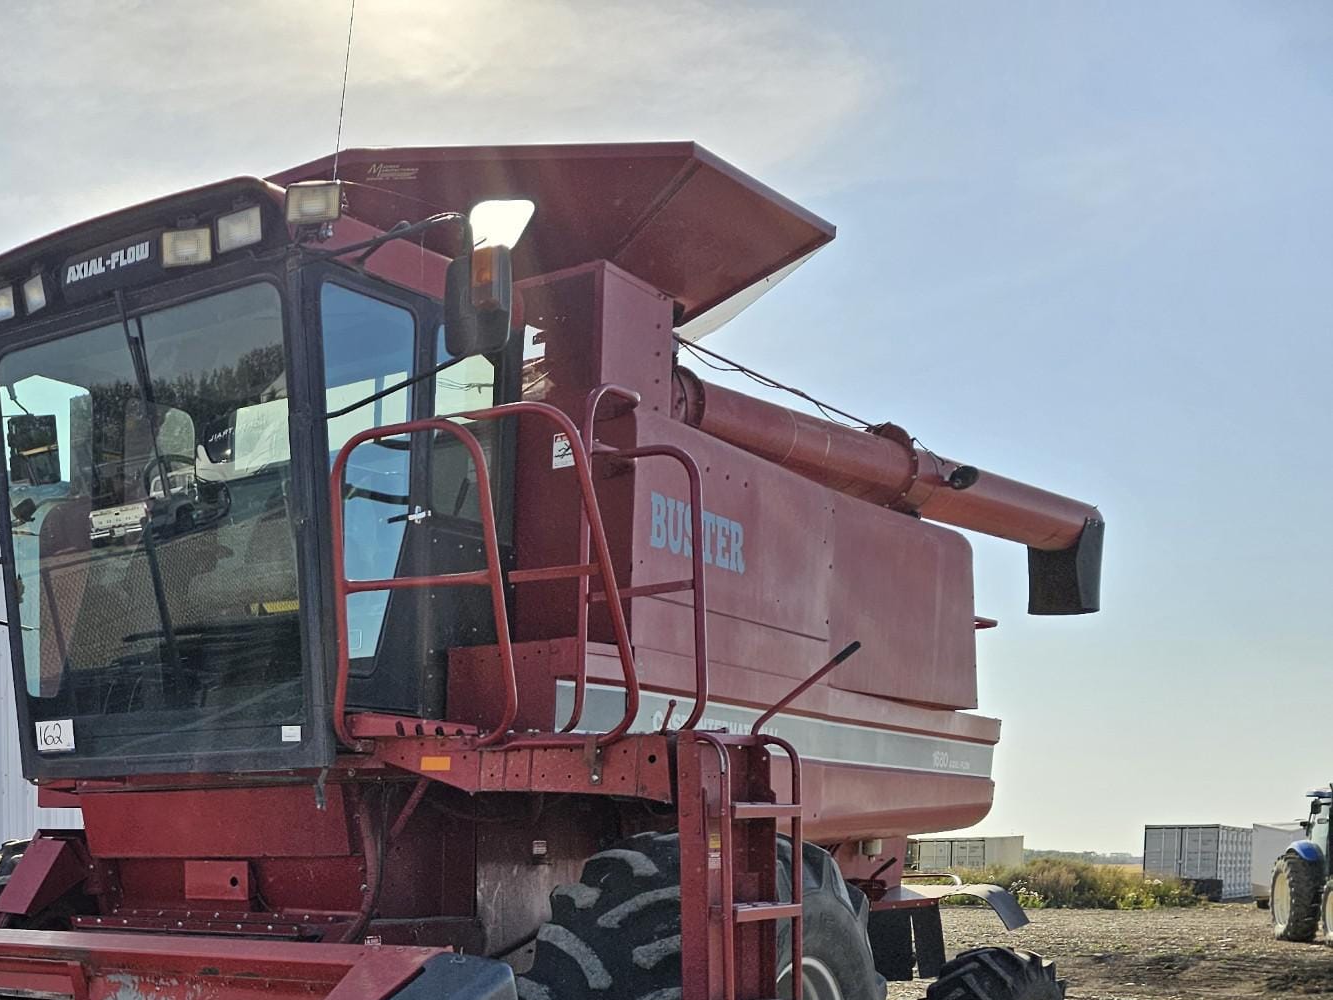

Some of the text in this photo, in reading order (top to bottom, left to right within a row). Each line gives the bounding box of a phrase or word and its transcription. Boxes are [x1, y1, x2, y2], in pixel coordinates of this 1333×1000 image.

[66, 241, 150, 284] AXIAL-FLOW
[650, 491, 745, 575] BUSTER
[39, 723, 63, 745] 162
